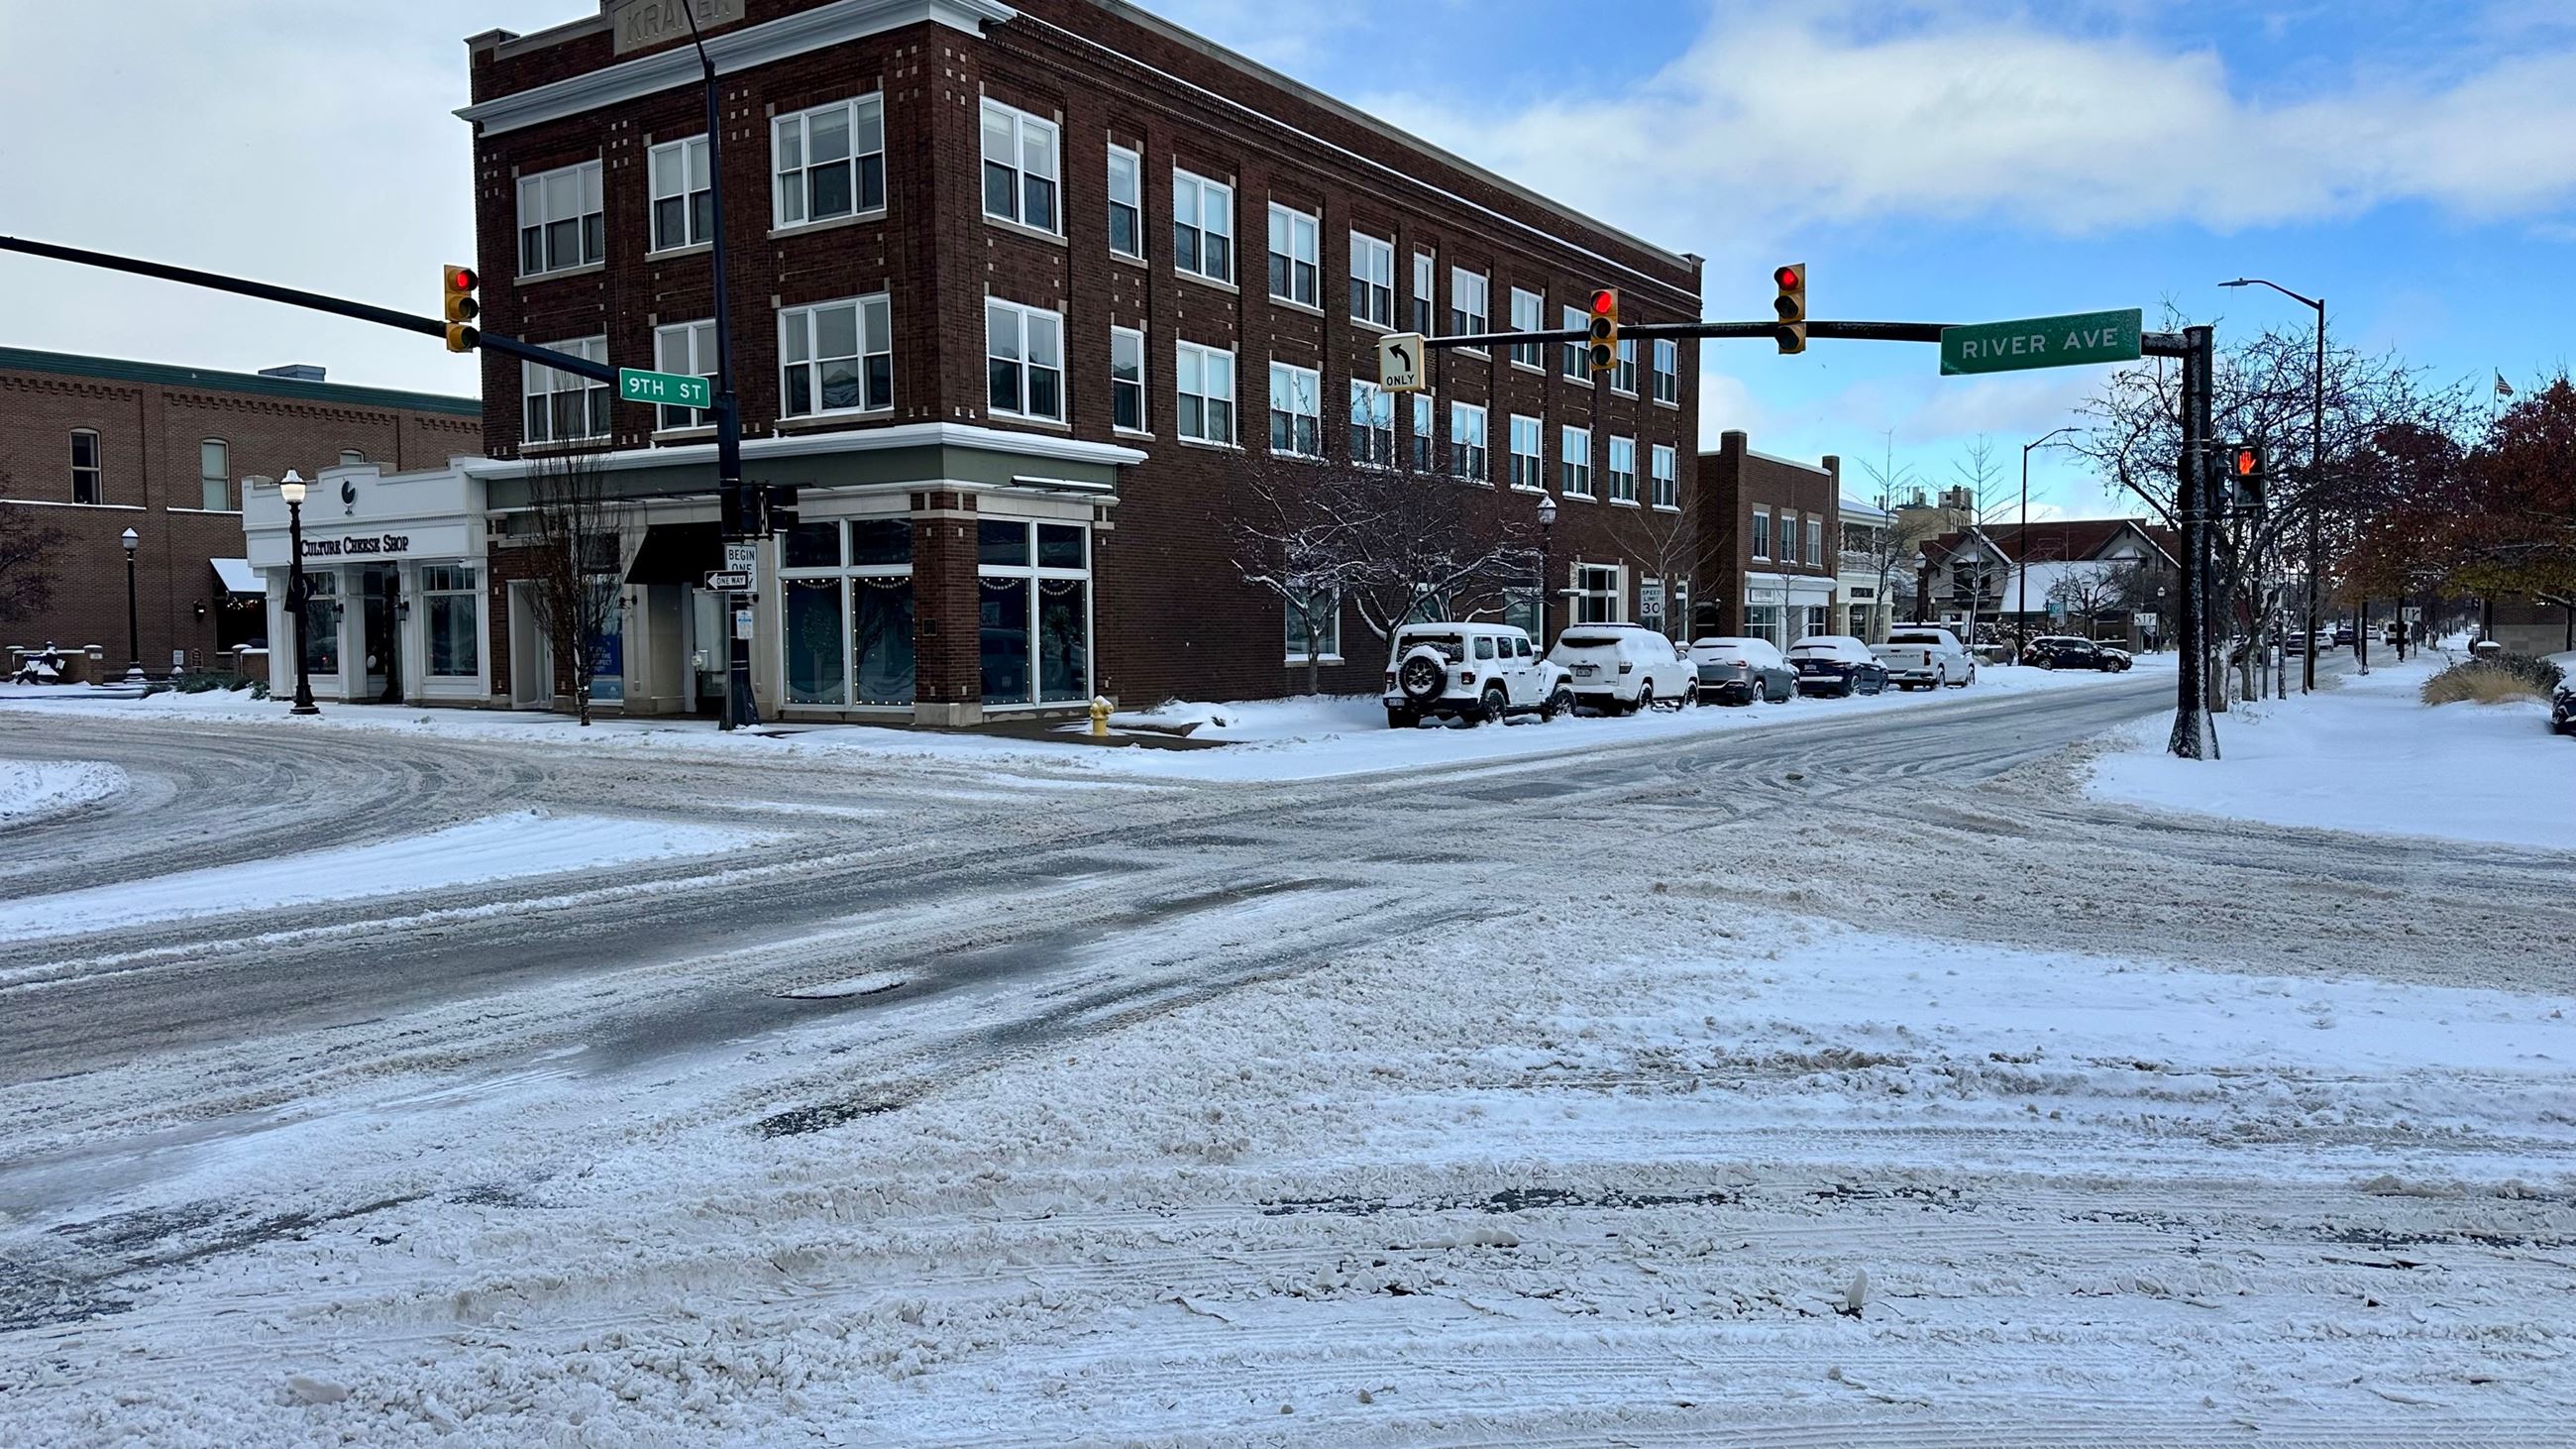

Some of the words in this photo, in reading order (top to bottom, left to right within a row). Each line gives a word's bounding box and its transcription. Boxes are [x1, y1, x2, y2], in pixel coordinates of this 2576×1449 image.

[1963, 334, 2046, 359] RIVER
[2063, 327, 2118, 350] AVE
[1386, 374, 1415, 387] ONLY
[629, 378, 664, 395] 9TH
[680, 383, 701, 399] ST
[300, 539, 341, 557] CULTURE
[343, 536, 380, 554] CHEESE
[383, 534, 409, 552] SHOP
[728, 549, 755, 561] BEGIN
[731, 563, 753, 573] ONE
[731, 576, 745, 585] WAY
[1643, 602, 1661, 614] 30
